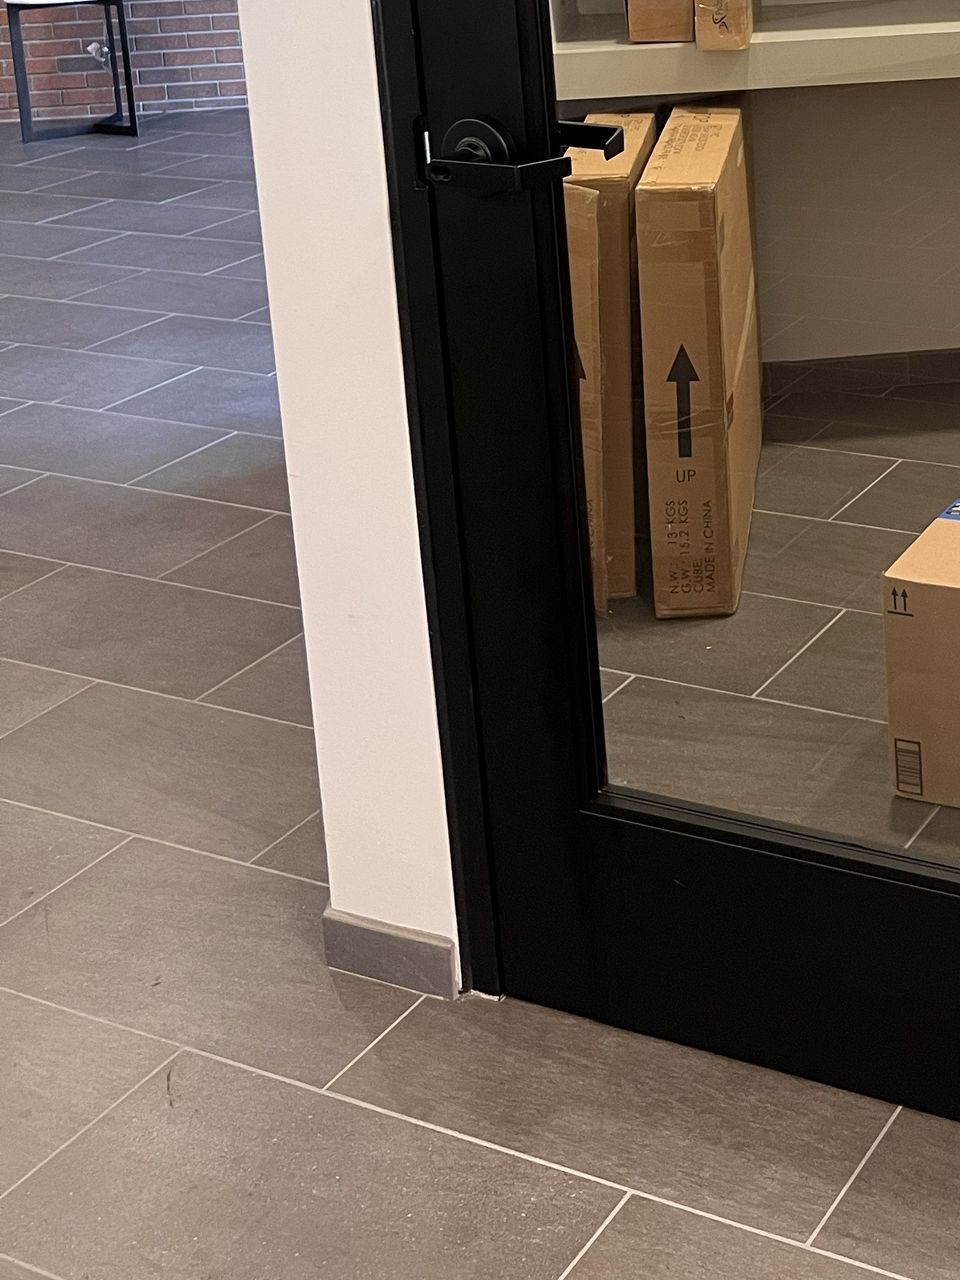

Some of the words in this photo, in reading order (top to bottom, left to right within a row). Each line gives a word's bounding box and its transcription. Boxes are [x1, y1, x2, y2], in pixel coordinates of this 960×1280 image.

[675, 469, 697, 483] UP
[665, 500, 677, 524] KGS
[677, 499, 689, 524] KGS
[702, 499, 714, 539] CHINA
[667, 531, 678, 545] 13
[679, 530, 690, 556] 15.2
[703, 542, 714, 554] IN
[704, 556, 715, 593] MADE
